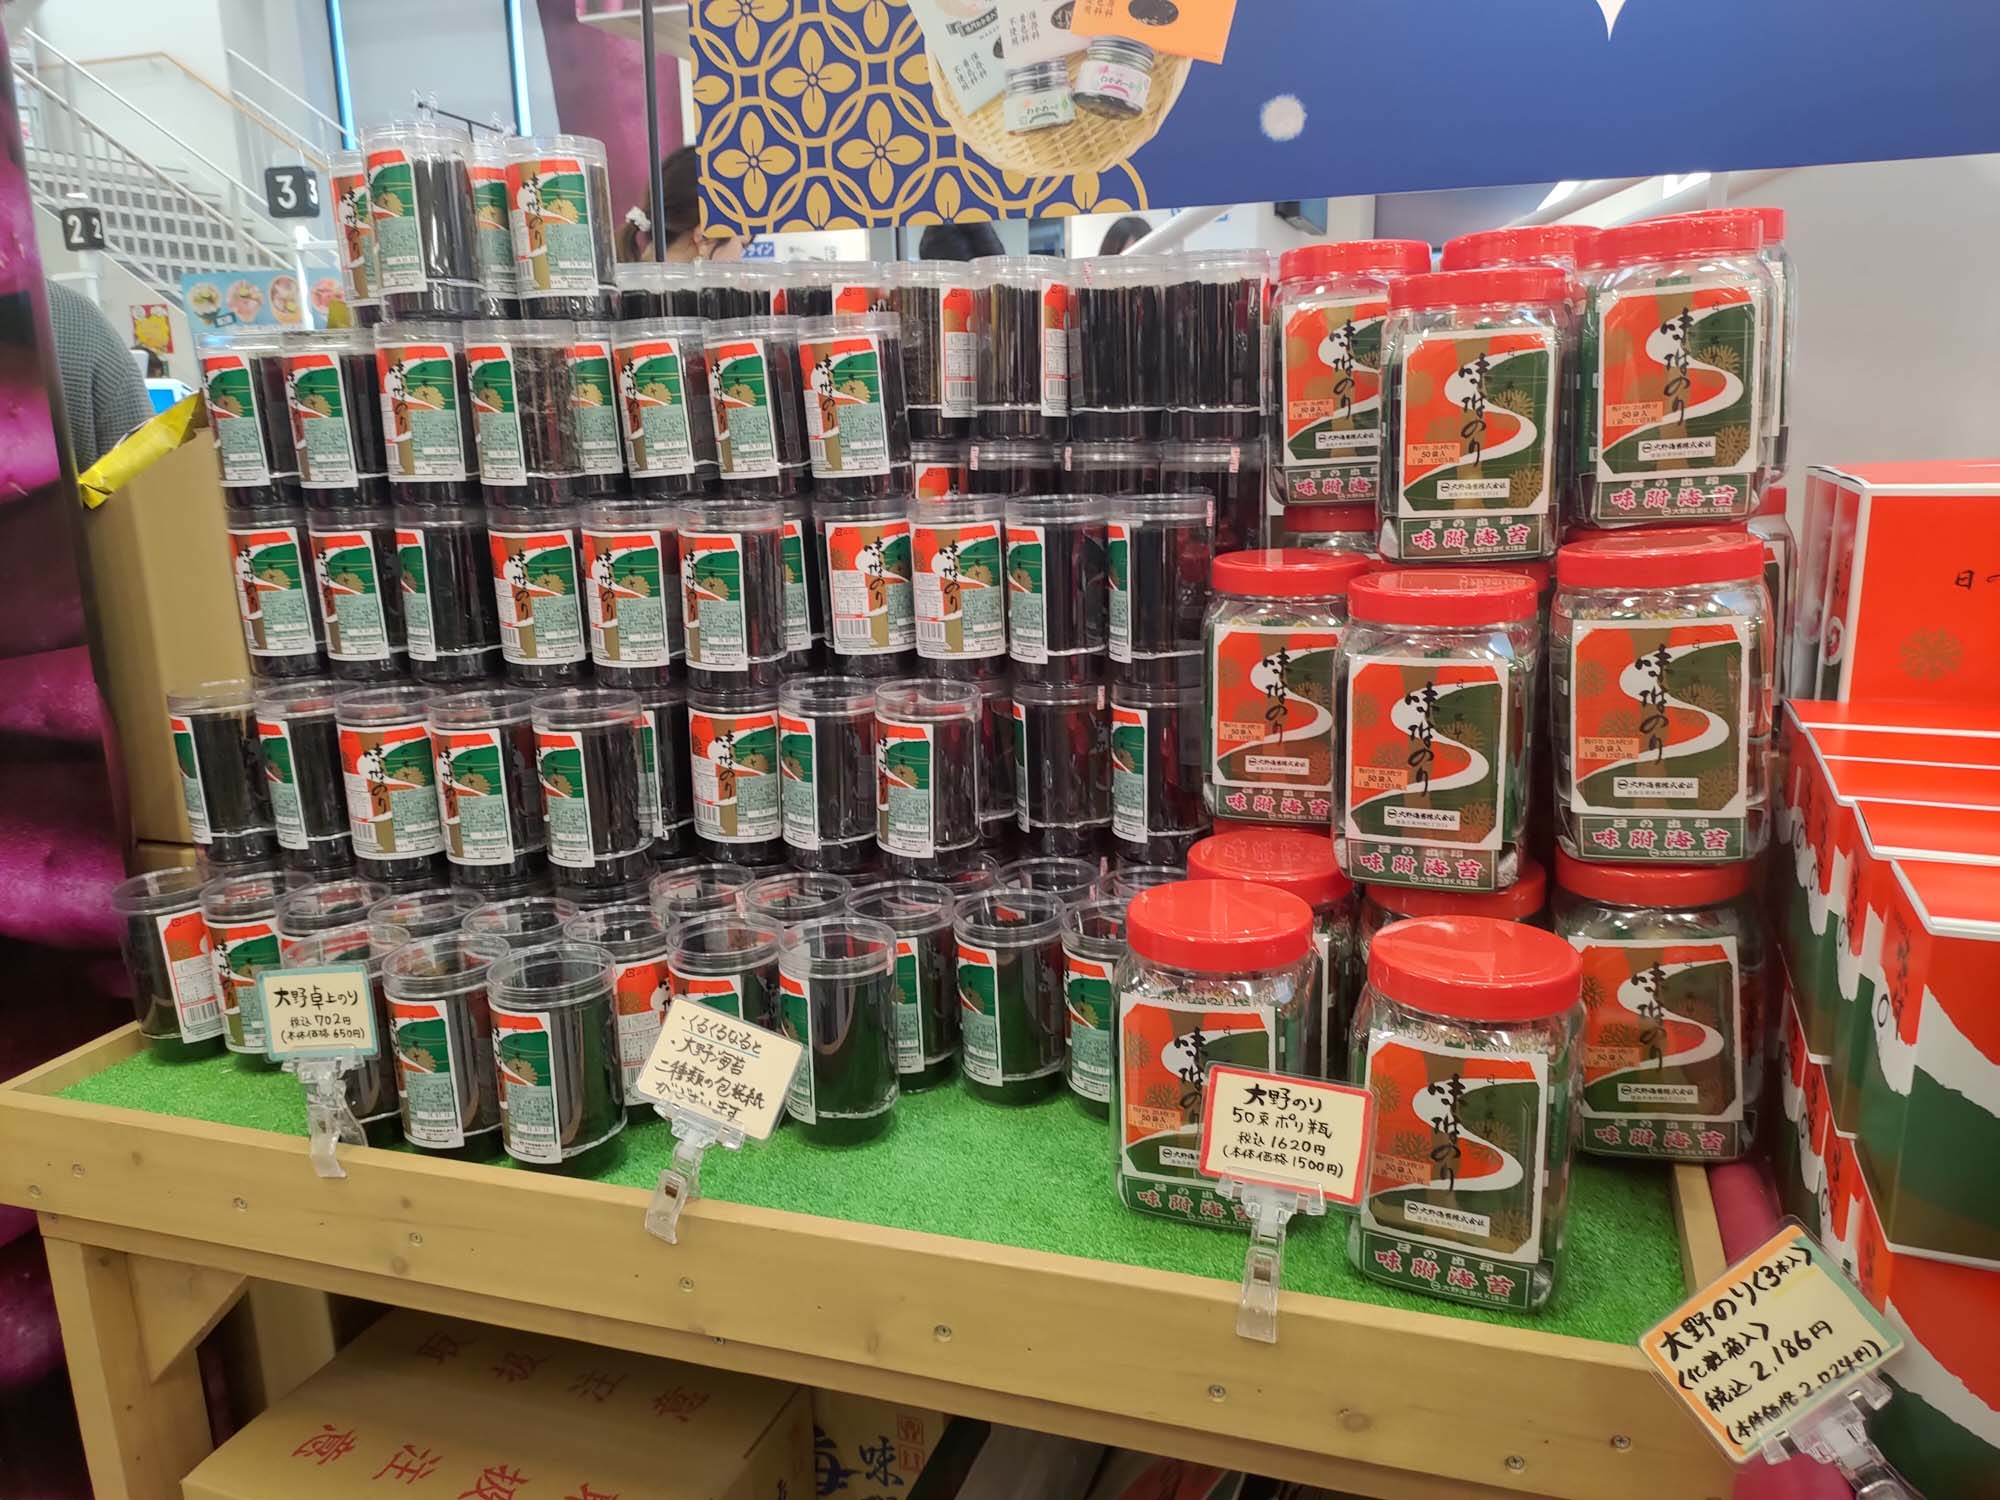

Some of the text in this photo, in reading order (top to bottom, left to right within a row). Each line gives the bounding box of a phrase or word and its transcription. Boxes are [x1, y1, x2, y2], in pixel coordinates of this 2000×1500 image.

[274, 174, 298, 210] 3
[307, 178, 319, 206] 3
[67, 215, 84, 243] 2
[92, 218, 103, 240] 2
[1609, 487, 1737, 508] 味附海苔
[1411, 526, 1531, 548] 味附海苔
[1226, 795, 1331, 815] 味附海苔
[1592, 828, 1731, 849] 味附海苔
[1360, 854, 1483, 880] 味附海苔
[273, 984, 358, 1010] 大野卓上のり
[315, 1013, 351, 1026] 702円
[655, 1059, 765, 1110] 二種類の包装紙
[1243, 1083, 1323, 1114] 大野のり
[1271, 1135, 1326, 1154] 1620円
[1594, 1126, 1726, 1150] 味附海苔
[1374, 1250, 1516, 1298] 味附海苔
[1704, 1379, 1752, 1413] 税込
